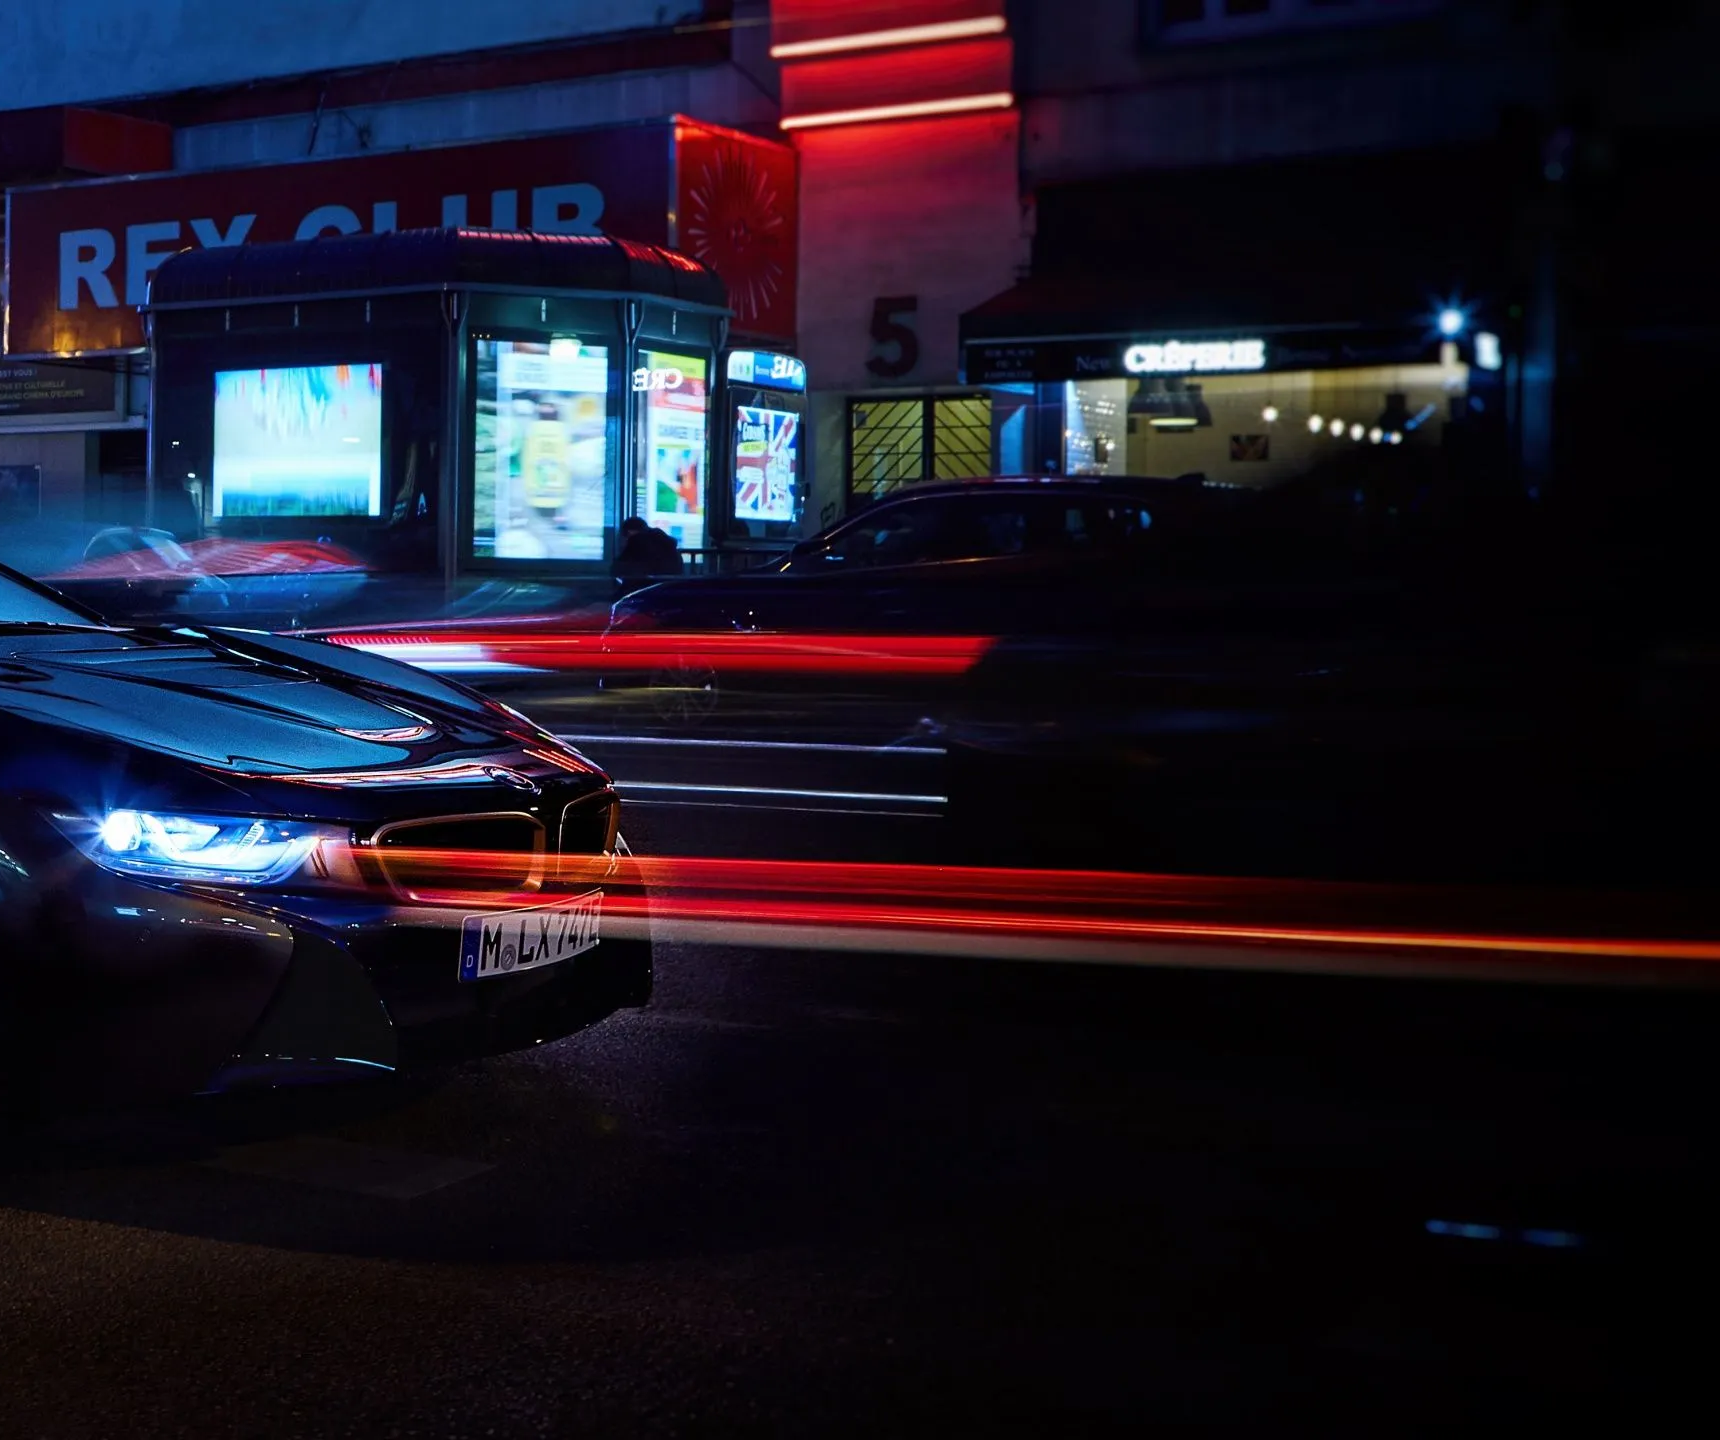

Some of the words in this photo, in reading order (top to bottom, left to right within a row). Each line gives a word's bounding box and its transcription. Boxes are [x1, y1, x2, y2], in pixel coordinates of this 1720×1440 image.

[865, 296, 918, 377] 5
[466, 955, 474, 968] D
[480, 922, 503, 971] M
[517, 911, 552, 965] LX
